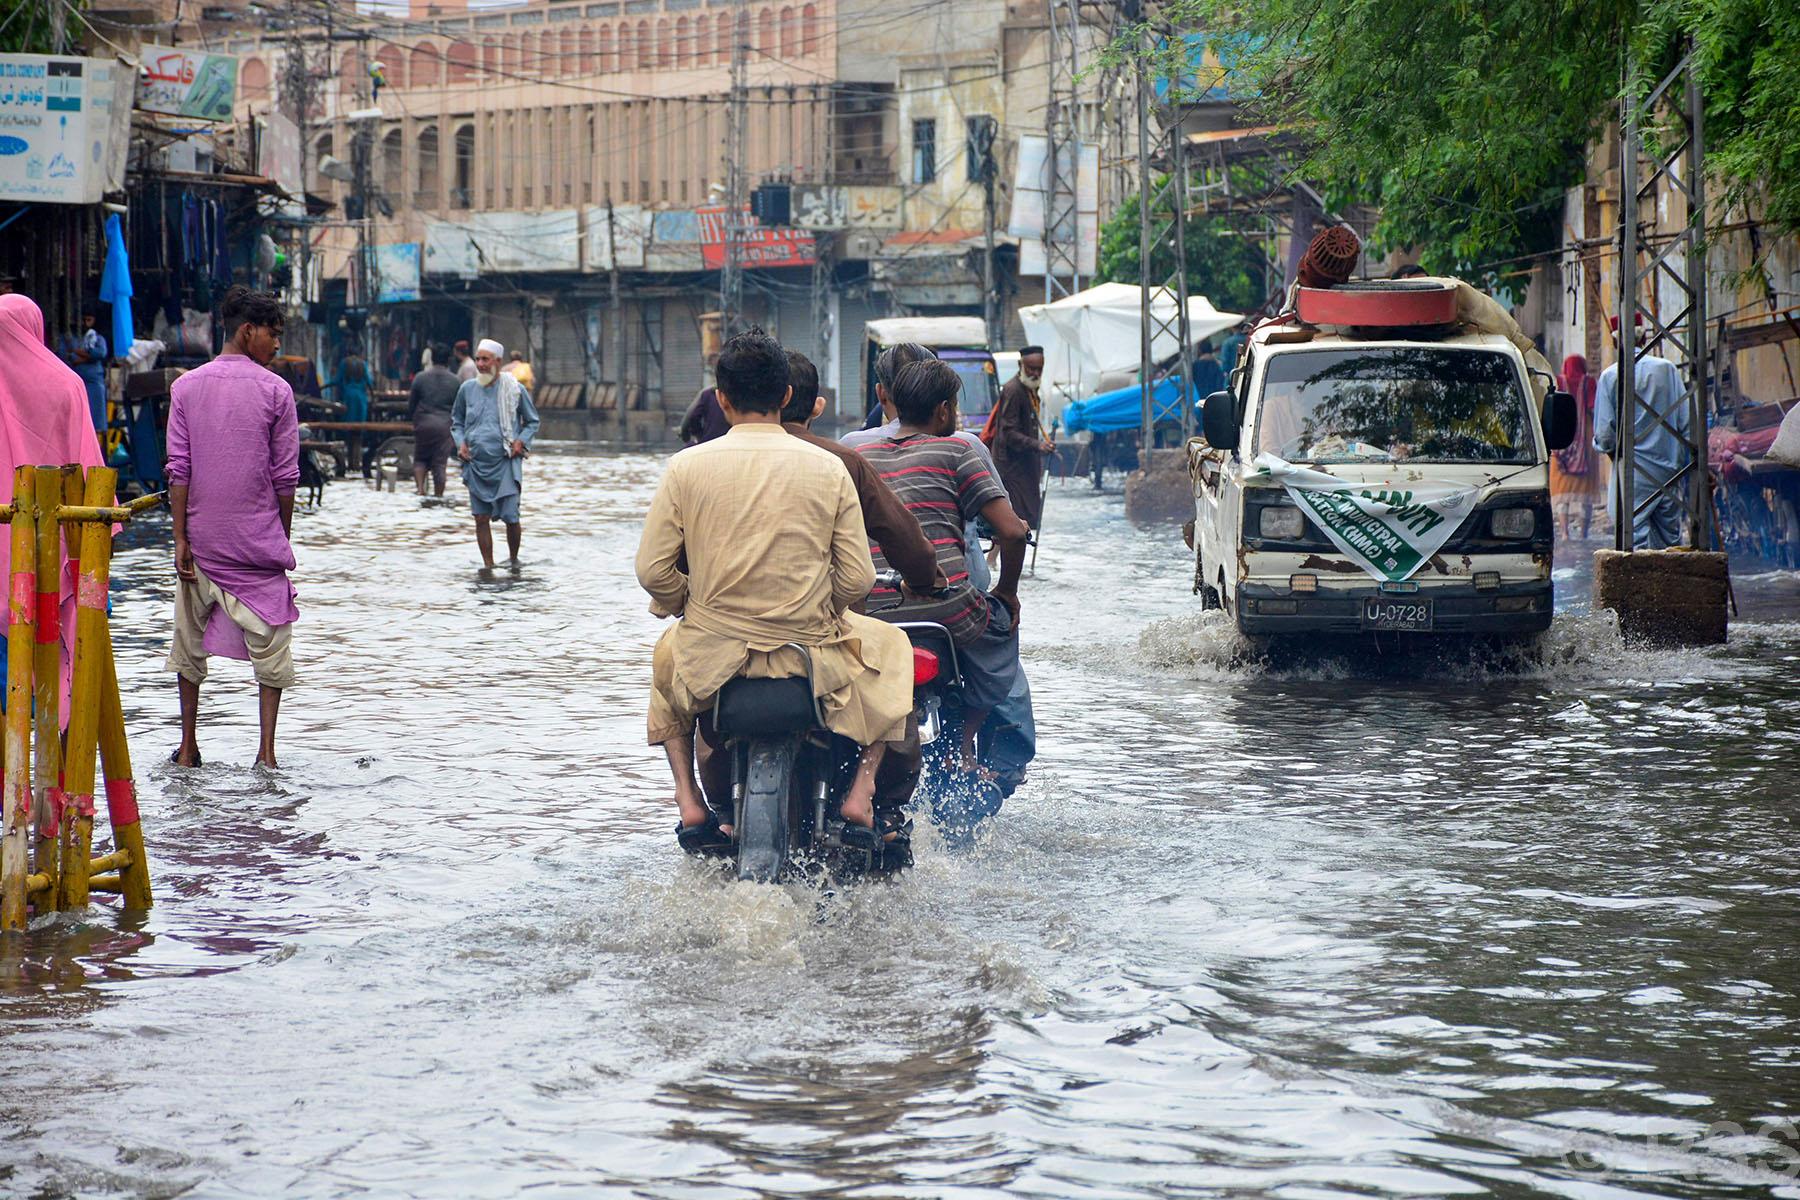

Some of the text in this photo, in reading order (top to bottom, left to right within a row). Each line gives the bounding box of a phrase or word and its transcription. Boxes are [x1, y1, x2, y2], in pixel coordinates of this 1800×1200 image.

[18, 64, 45, 79] COMPANY
[1338, 501, 1403, 554] MUNICIPAL
[1342, 525, 1382, 559] (HMC)
[1367, 604, 1427, 621] U-0728
